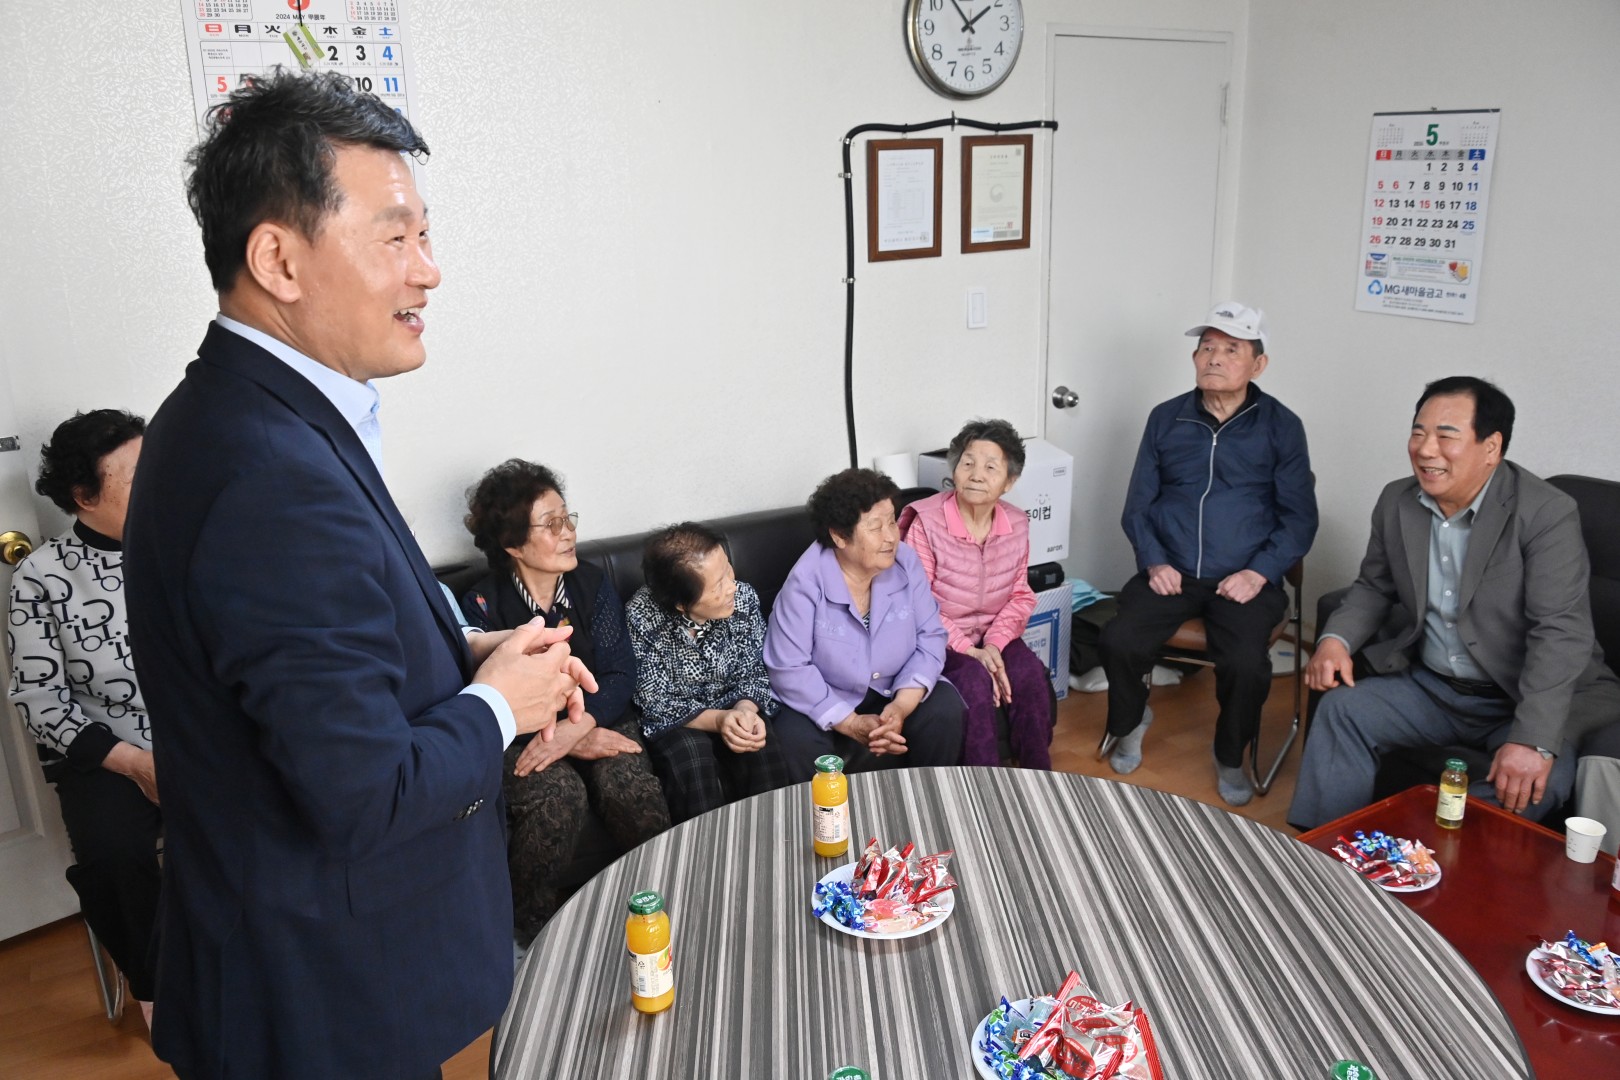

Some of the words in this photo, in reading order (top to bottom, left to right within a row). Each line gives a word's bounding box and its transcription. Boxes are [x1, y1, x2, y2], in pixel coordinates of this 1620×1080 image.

[929, 0, 943, 11] 10
[205, 23, 222, 32] 日
[234, 24, 251, 33] 月
[265, 25, 281, 33] 火
[323, 26, 338, 34] 木
[352, 26, 366, 35] 金
[379, 26, 393, 35] 土
[924, 19, 935, 36] 9
[1000, 15, 1010, 31] 3
[328, 45, 338, 61] 2
[356, 45, 366, 61] 3
[383, 46, 393, 60] 4
[931, 43, 942, 61] 8
[994, 41, 1005, 56] 4
[947, 61, 957, 77] 7
[964, 65, 975, 82] 6
[982, 58, 992, 74] 5
[218, 76, 227, 92] 5
[355, 77, 372, 92] 10
[384, 77, 398, 92] 11
[1426, 124, 1439, 146] 5
[1427, 163, 1432, 171] 1
[1440, 163, 1447, 172] 2
[1457, 163, 1464, 172] 3
[1472, 163, 1478, 172] 4
[1378, 181, 1384, 189] 5
[1392, 181, 1399, 189] 6
[1409, 181, 1415, 190] 7
[1424, 181, 1430, 190] 8
[1439, 182, 1445, 191] 9
[1452, 182, 1463, 191] 10
[1467, 182, 1479, 192] 11
[1374, 199, 1384, 208] 12
[1389, 199, 1399, 208] 13
[1404, 200, 1415, 208] 14
[1419, 200, 1430, 209] 15
[1435, 200, 1445, 209] 16
[1450, 201, 1461, 210] 17
[1465, 201, 1477, 210] 18
[1372, 217, 1383, 225] 19
[1386, 217, 1398, 226] 20
[1401, 218, 1413, 226] 21
[1417, 218, 1428, 227] 22
[1431, 219, 1443, 228] 23
[1446, 220, 1458, 229] 24
[1462, 220, 1475, 230] 25
[1369, 236, 1381, 244] 26
[1384, 236, 1396, 245] 27
[1399, 237, 1411, 245] 28
[1414, 237, 1426, 246] 29
[1429, 238, 1441, 247] 30
[1444, 239, 1456, 248] 31
